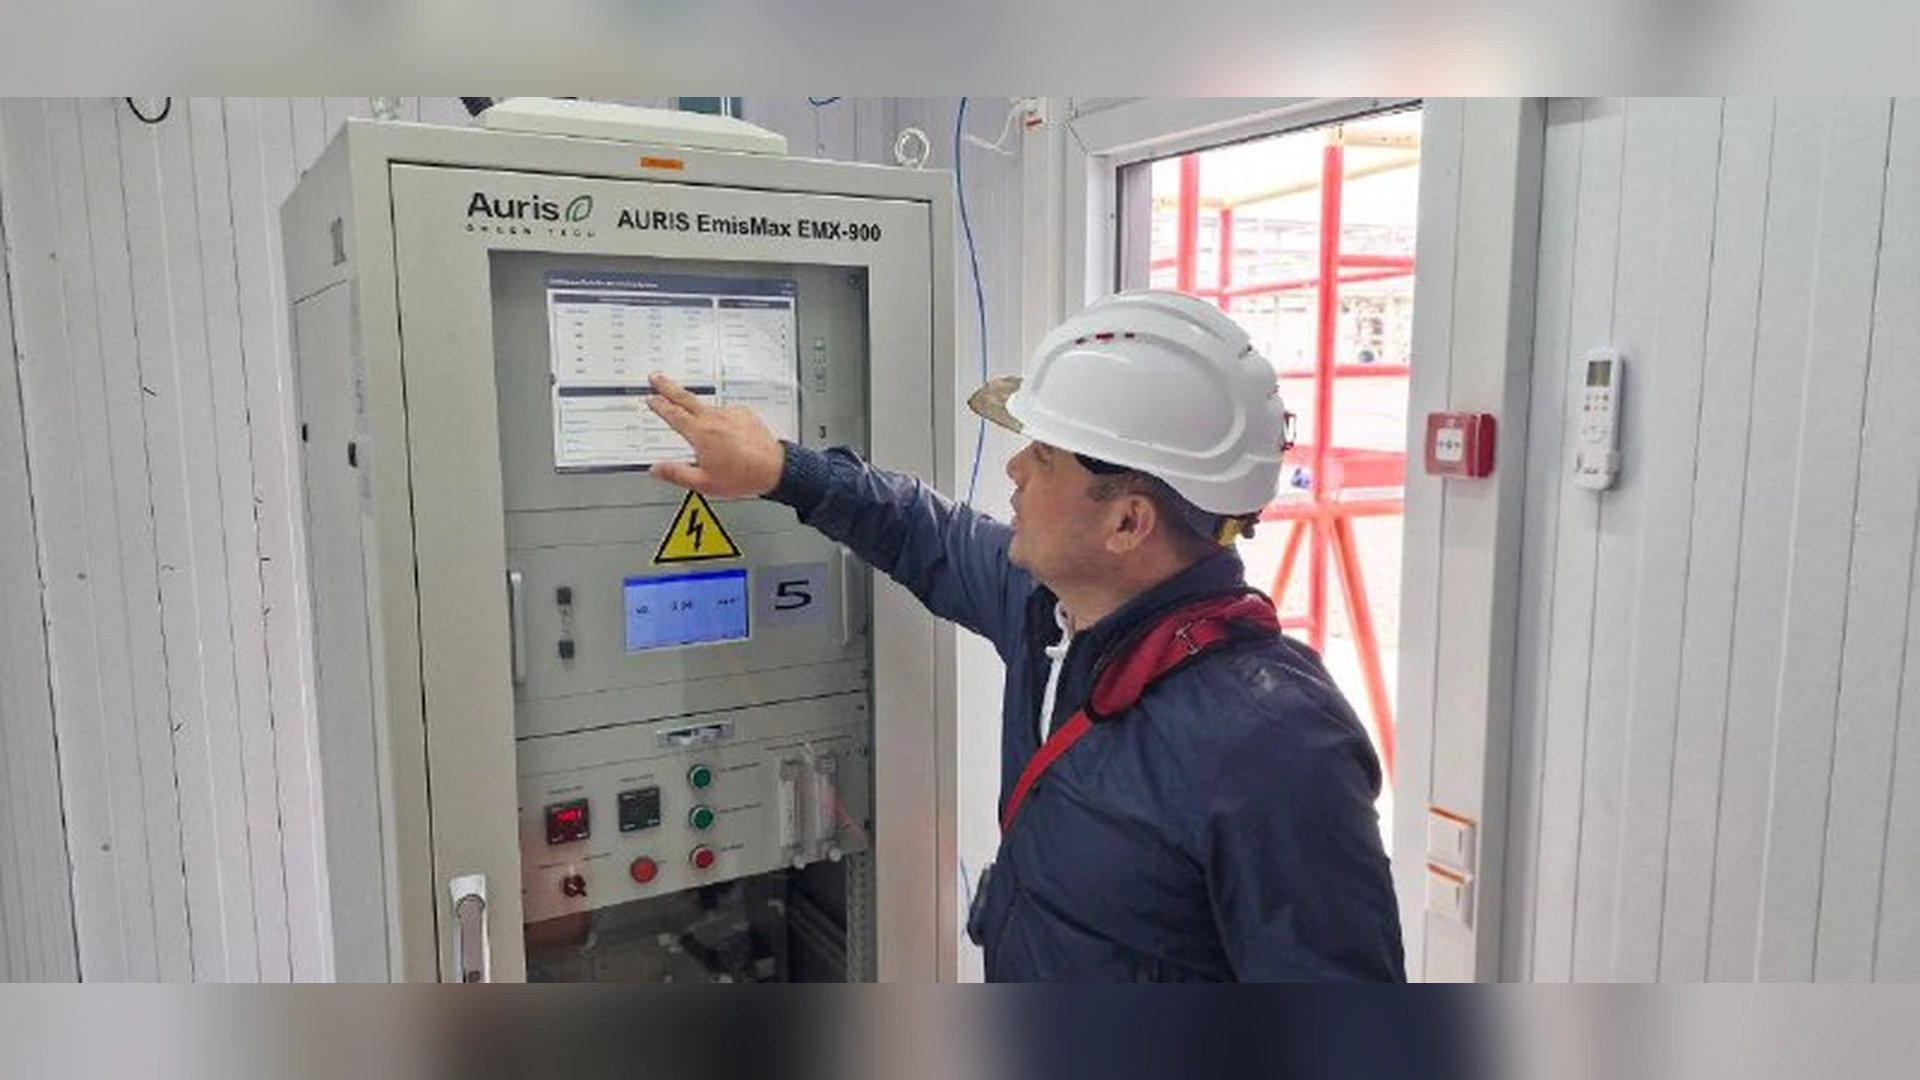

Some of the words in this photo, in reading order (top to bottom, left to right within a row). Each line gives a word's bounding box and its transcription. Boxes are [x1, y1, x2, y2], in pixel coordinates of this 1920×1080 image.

[467, 192, 559, 221] Auris
[617, 210, 690, 231] AURIS
[698, 214, 792, 238] EmisMax
[798, 220, 882, 242] EMX-900
[774, 579, 813, 611] 5
